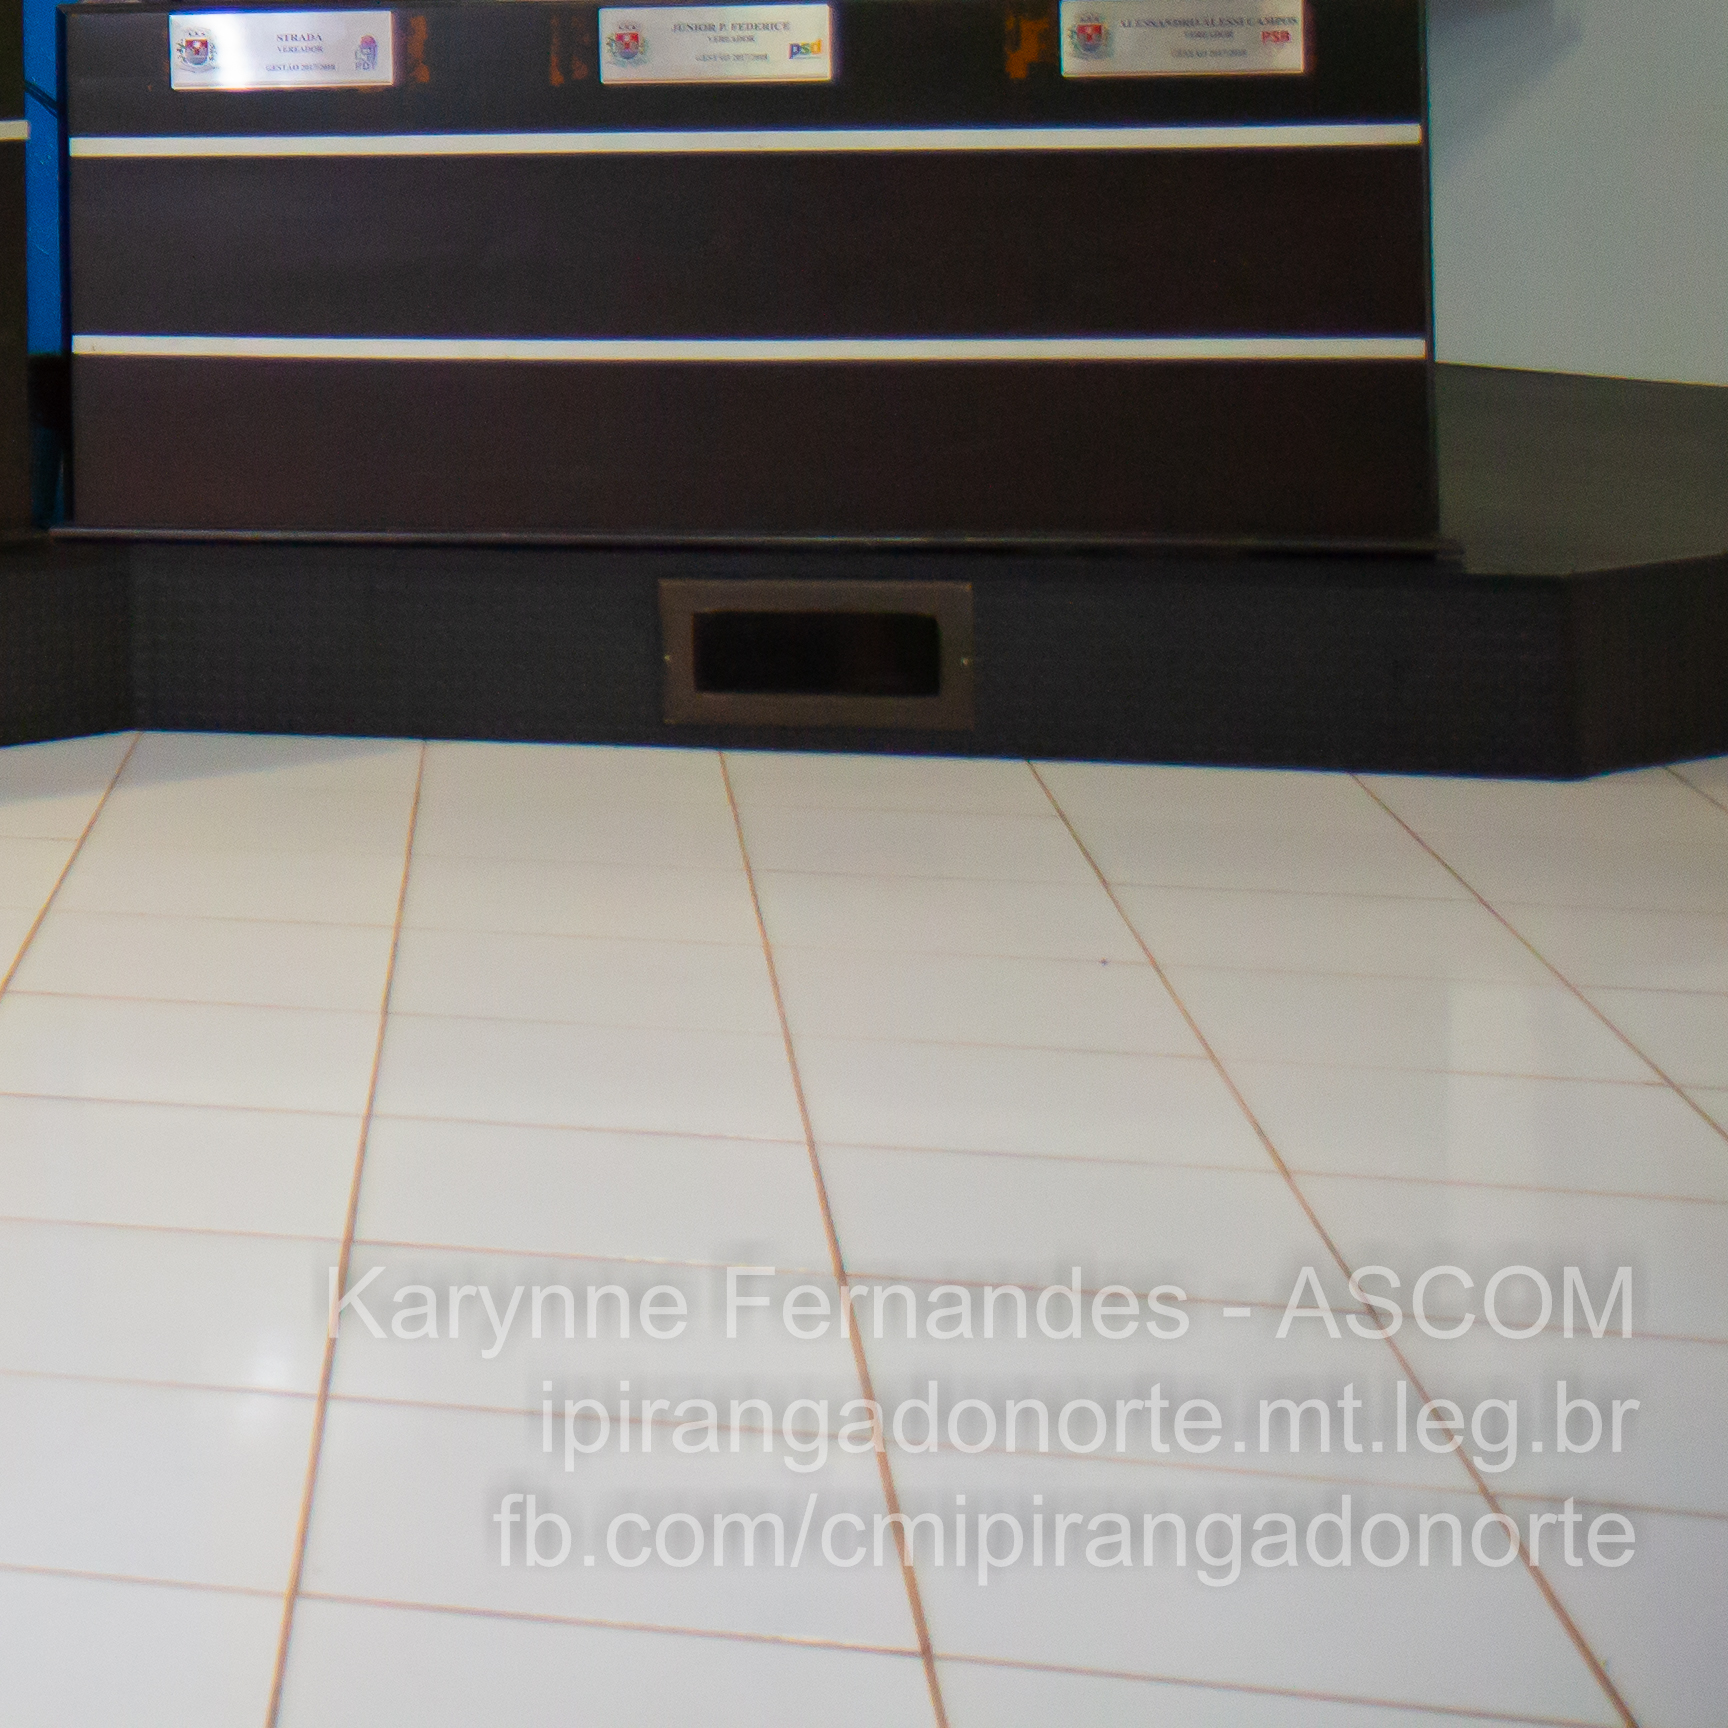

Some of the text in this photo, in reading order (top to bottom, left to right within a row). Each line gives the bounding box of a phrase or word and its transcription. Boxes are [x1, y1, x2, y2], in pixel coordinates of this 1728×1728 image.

[276, 33, 323, 42] STRADA
[1260, 30, 1292, 45] PSB
[276, 45, 324, 53] VEREADOR
[788, 38, 823, 60] psd
